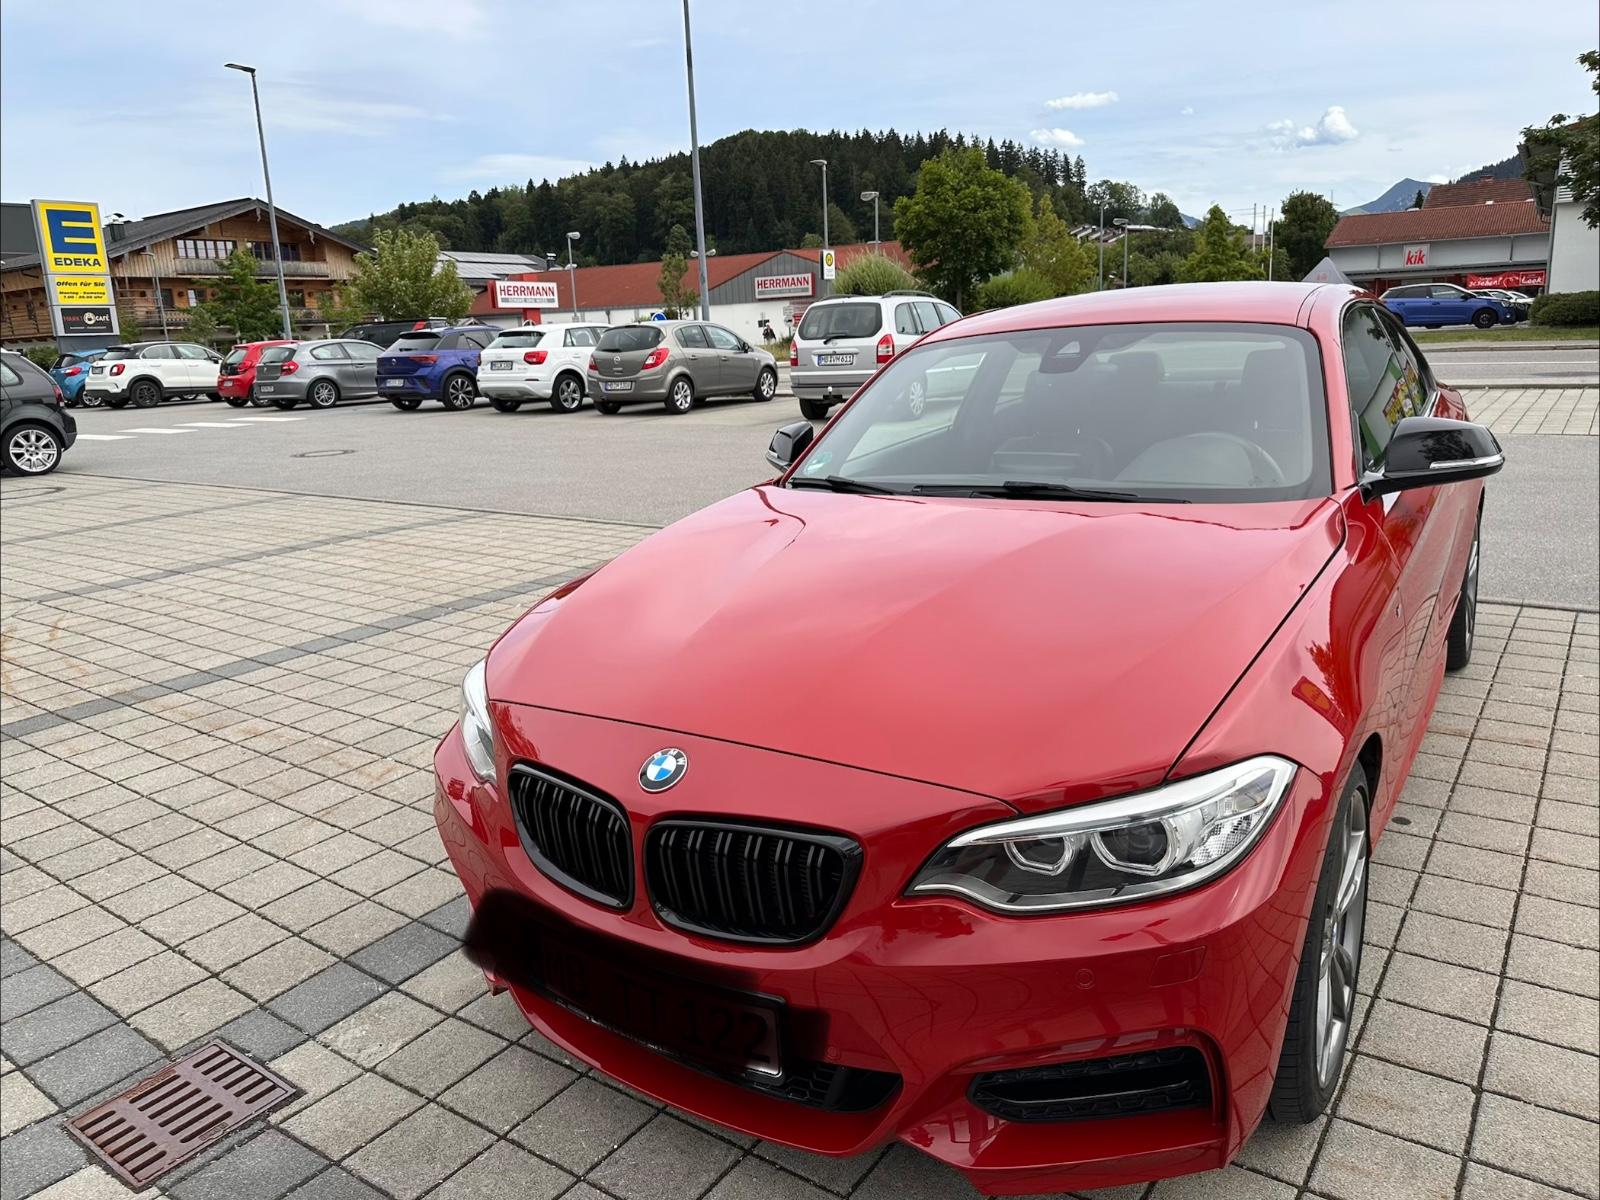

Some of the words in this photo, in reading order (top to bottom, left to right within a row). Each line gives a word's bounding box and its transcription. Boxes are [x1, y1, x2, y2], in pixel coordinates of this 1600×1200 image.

[54, 257, 101, 267] EDEKA
[757, 276, 809, 289] HERRMANN
[500, 285, 555, 296] HERRMANN
[654, 749, 686, 766] BMW
[677, 1000, 771, 1064] 122
